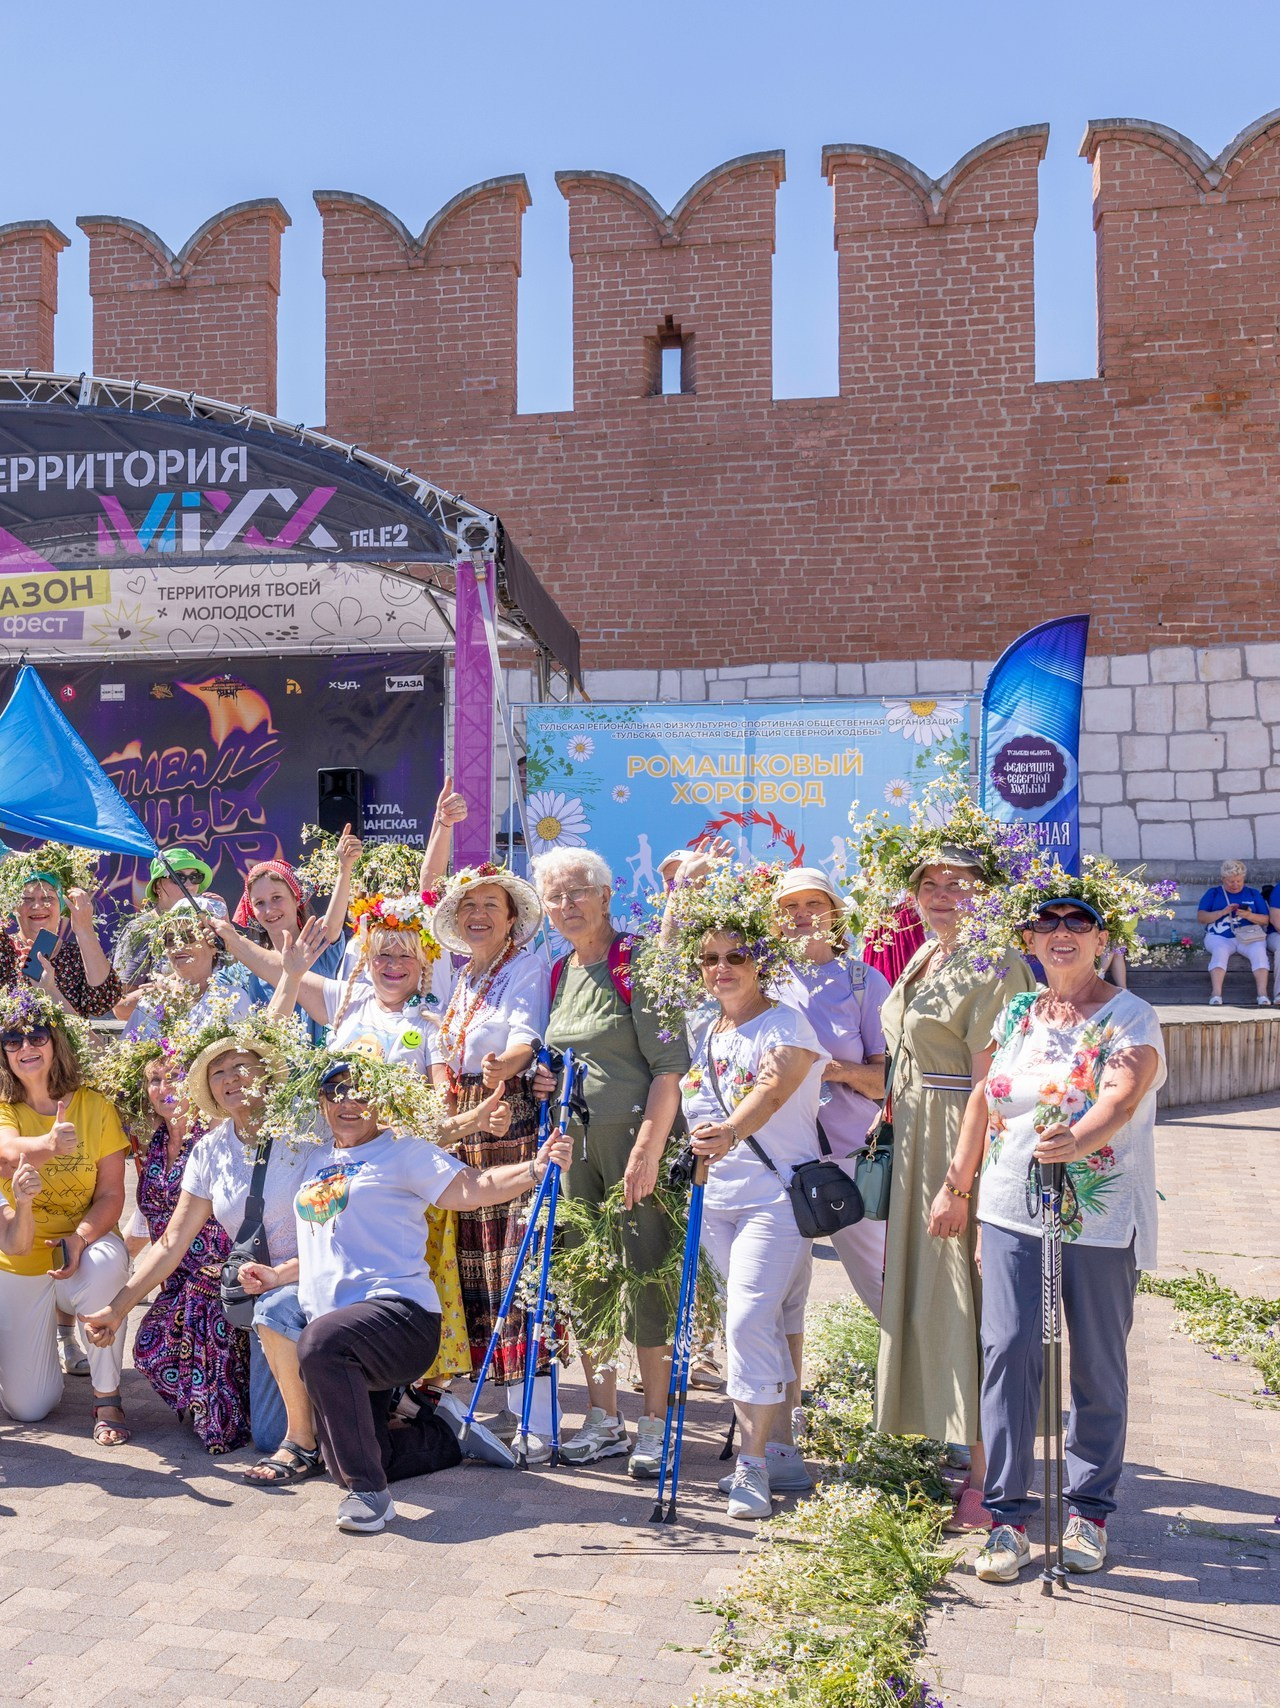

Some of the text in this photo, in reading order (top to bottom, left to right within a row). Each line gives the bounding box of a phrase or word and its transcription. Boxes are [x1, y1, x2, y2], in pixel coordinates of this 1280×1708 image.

[349, 524, 409, 548] TELE2
[157, 578, 321, 601] ТЕРРИТОРИЯ ТВОЕЙ
[182, 604, 295, 622] МОЛОДОСТИ
[2, 613, 68, 638] фест
[396, 680, 423, 689] БАЗА
[539, 723, 585, 731] ТУЛЬСКАЯ
[587, 721, 662, 731] РЕГИОНАЛЬНАЯ
[806, 719, 886, 728] ОБЩЕСТВЕННАЯ
[887, 717, 959, 727] ОРГАНИЗАЦИЯ
[612, 728, 882, 739] «ТУЛЬСКАЯ ОБЛАСТНАЯ ФЕДЕРАЦИЯ СЕВЕРНОЙ ХОДЬБЫ»
[627, 748, 864, 778] РОМАШКОВЫЙ
[1004, 762, 1055, 774] ФЕДЕРАЦИЯ
[1006, 773, 1051, 784] СЕВЕРНОЙ
[672, 780, 827, 808] ХОРОВОД
[1010, 783, 1047, 795] ХОДЬБЫ
